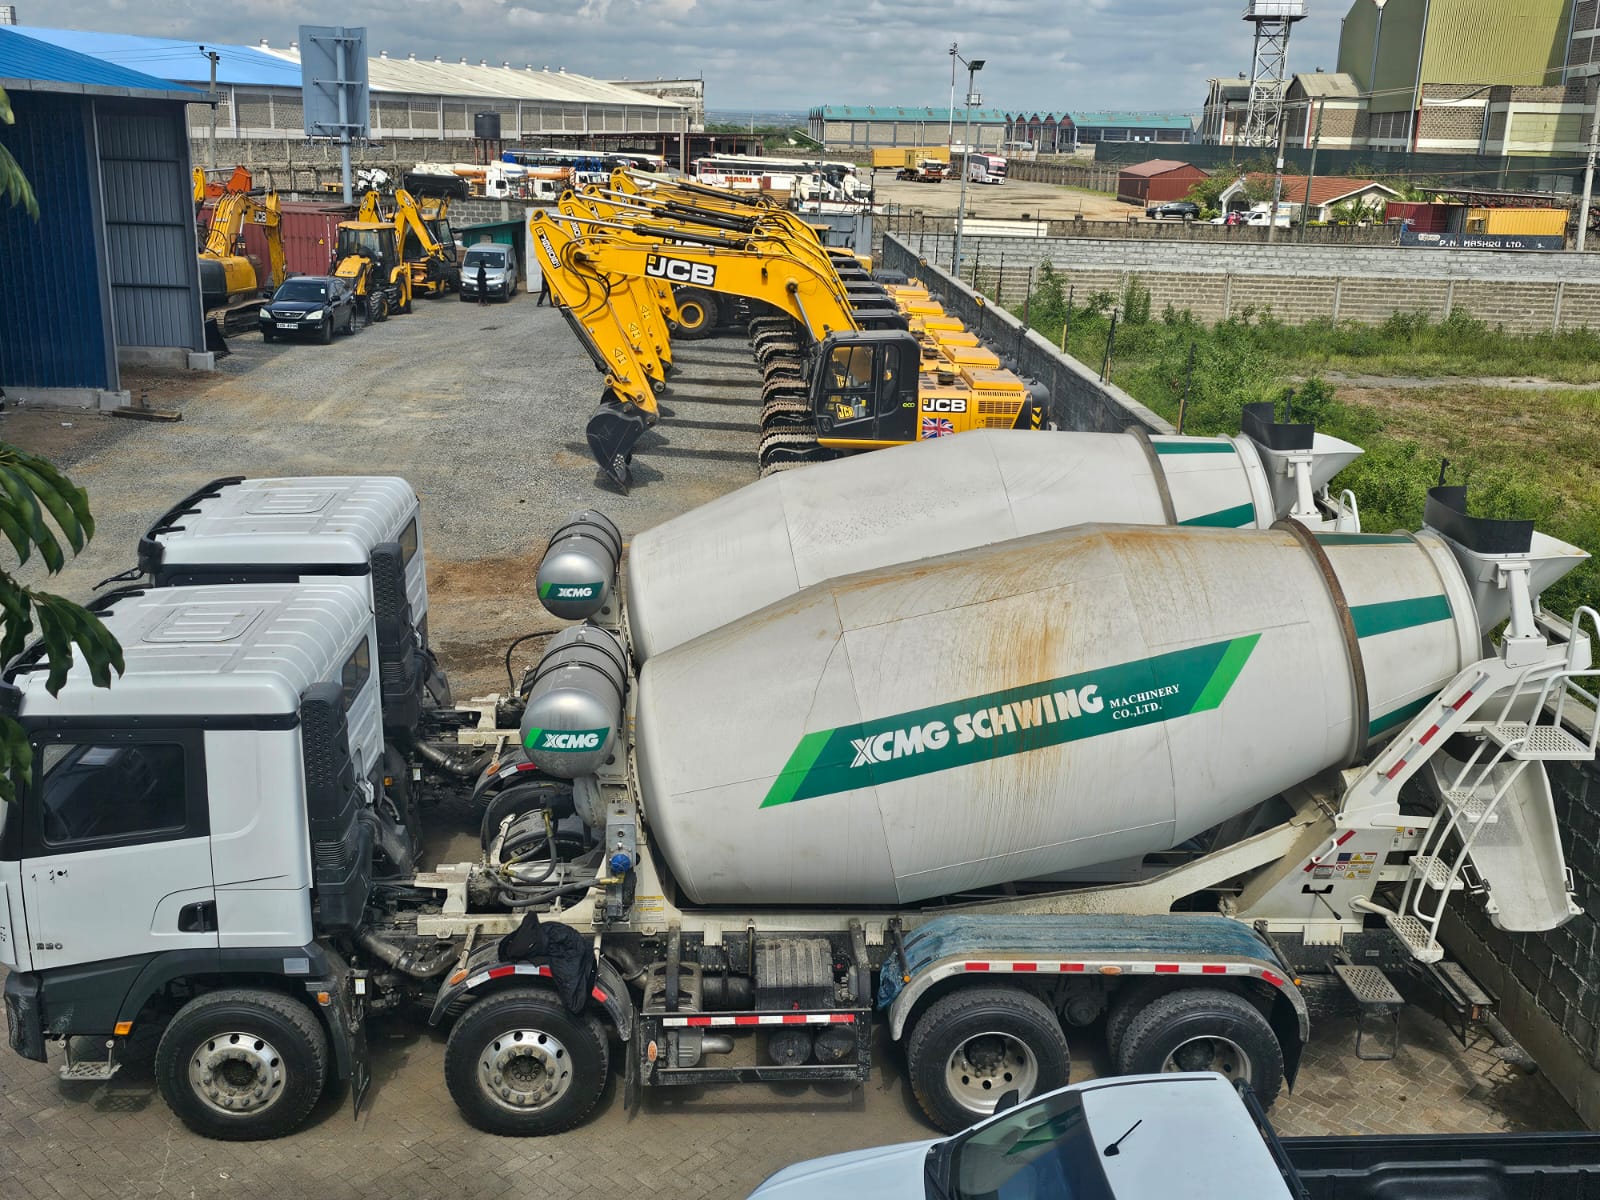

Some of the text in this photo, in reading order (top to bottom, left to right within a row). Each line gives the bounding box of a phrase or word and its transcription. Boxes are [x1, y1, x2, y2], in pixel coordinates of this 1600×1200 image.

[1464, 240, 1501, 248] MASHRU
[646, 255, 716, 286] JCB
[836, 404, 855, 419] JCB
[923, 398, 967, 412] JCB
[557, 587, 592, 597] XCMG
[1109, 683, 1181, 710] MACHINERY
[850, 684, 1103, 768] XCMG SCHWING
[542, 733, 600, 749] XCMG
